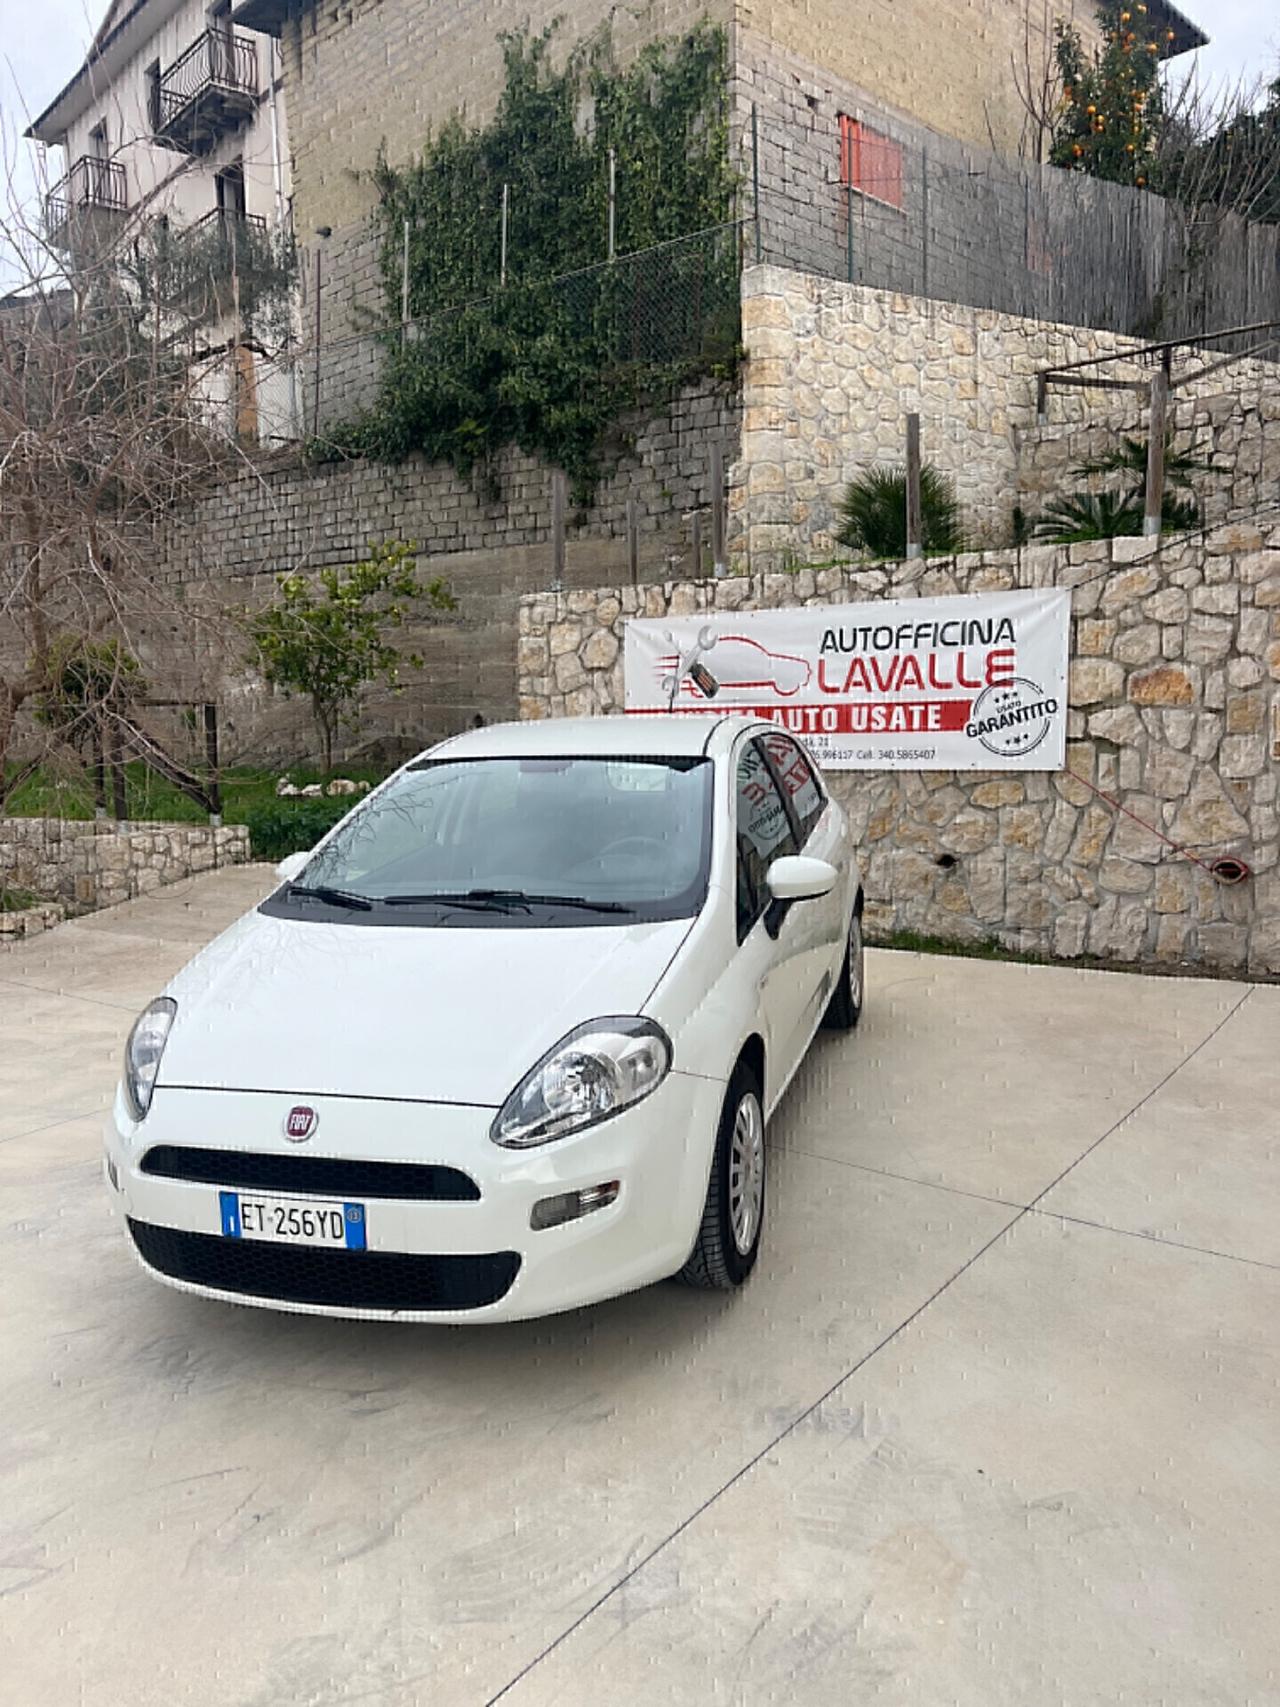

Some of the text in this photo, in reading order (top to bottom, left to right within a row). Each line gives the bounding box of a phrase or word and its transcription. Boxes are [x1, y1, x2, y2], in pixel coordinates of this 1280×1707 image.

[820, 618, 1016, 654] AUTOFFICINA
[817, 648, 1015, 694] LAVALLE
[773, 706, 838, 732] AUTO
[851, 704, 942, 732] USATE
[966, 699, 1058, 738] GARANTITO
[996, 700, 1022, 714] USATO
[289, 1114, 312, 1131] FIAT
